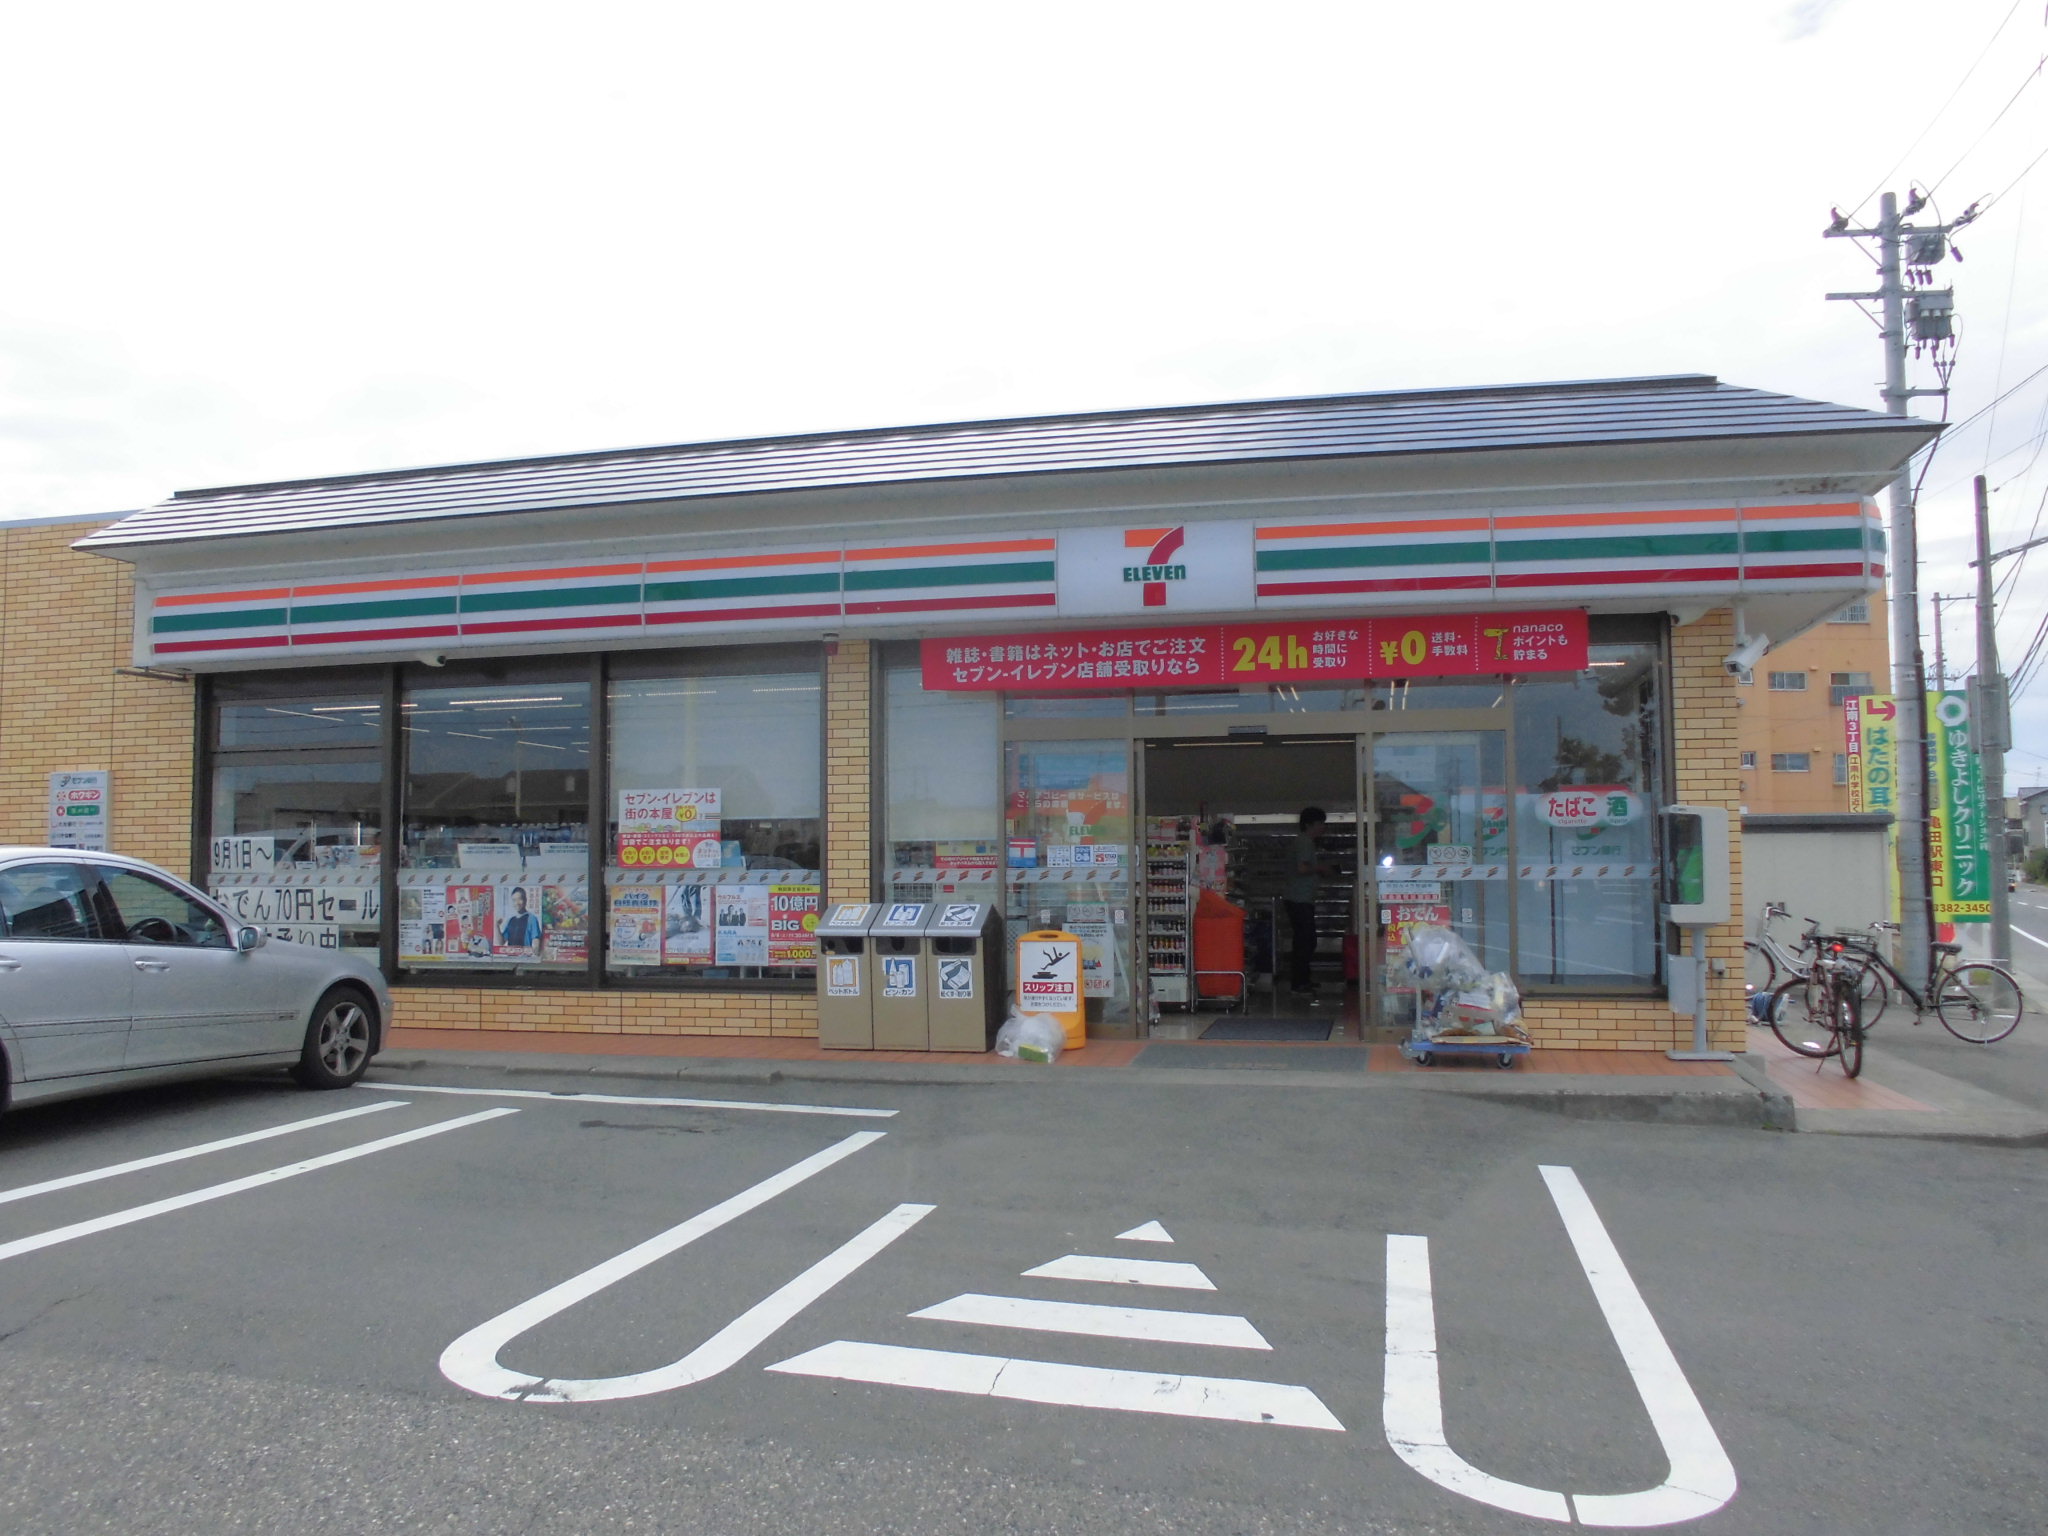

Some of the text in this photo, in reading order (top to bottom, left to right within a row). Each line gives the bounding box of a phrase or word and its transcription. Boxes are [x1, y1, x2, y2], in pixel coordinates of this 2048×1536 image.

[1512, 622, 1564, 633] nanaco
[1312, 630, 1358, 642] お好きな
[1512, 634, 1568, 647] ポイントも
[946, 636, 1206, 664] 雑誌・書籍はネット・お店でご注文
[1232, 634, 1308, 672] 24h
[1312, 643, 1348, 655] 時間に
[1380, 631, 1427, 665] ¥0
[1431, 644, 1468, 657] 手数料
[1512, 648, 1548, 661] 貯まる
[1312, 656, 1346, 668] 受取り
[1845, 700, 1859, 753] 江南3丁目
[1548, 796, 1597, 817] たばこ
[1606, 796, 1628, 816] 酒
[625, 807, 673, 820] 街の本屋
[1948, 730, 1974, 897] ゆきよしクリニック
[771, 895, 818, 912] 10億円
[1396, 905, 1438, 921] おでん
[1024, 983, 1072, 993] スリップ注意
